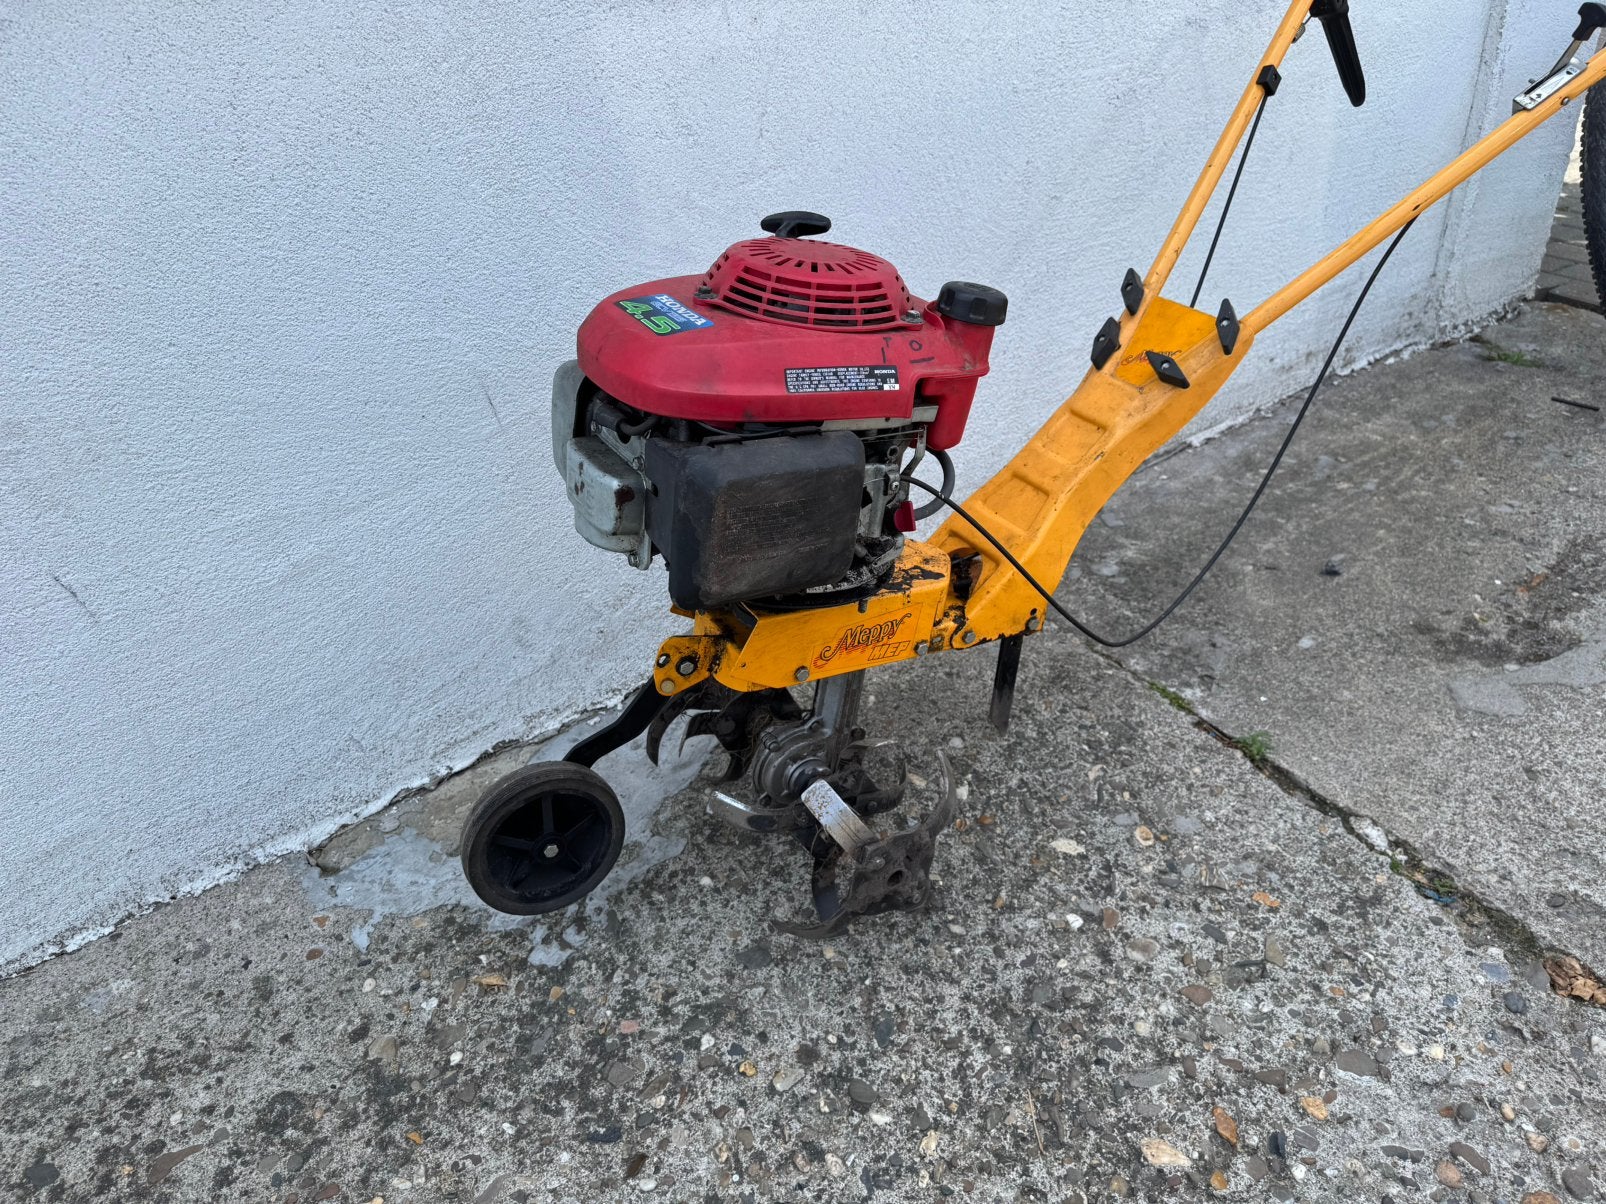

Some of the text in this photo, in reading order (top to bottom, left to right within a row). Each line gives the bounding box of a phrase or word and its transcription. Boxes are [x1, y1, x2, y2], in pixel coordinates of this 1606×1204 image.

[619, 301, 681, 334] 4.5
[655, 294, 707, 326] HONDA
[820, 612, 912, 662] Meppy
[867, 640, 912, 662] MEP
